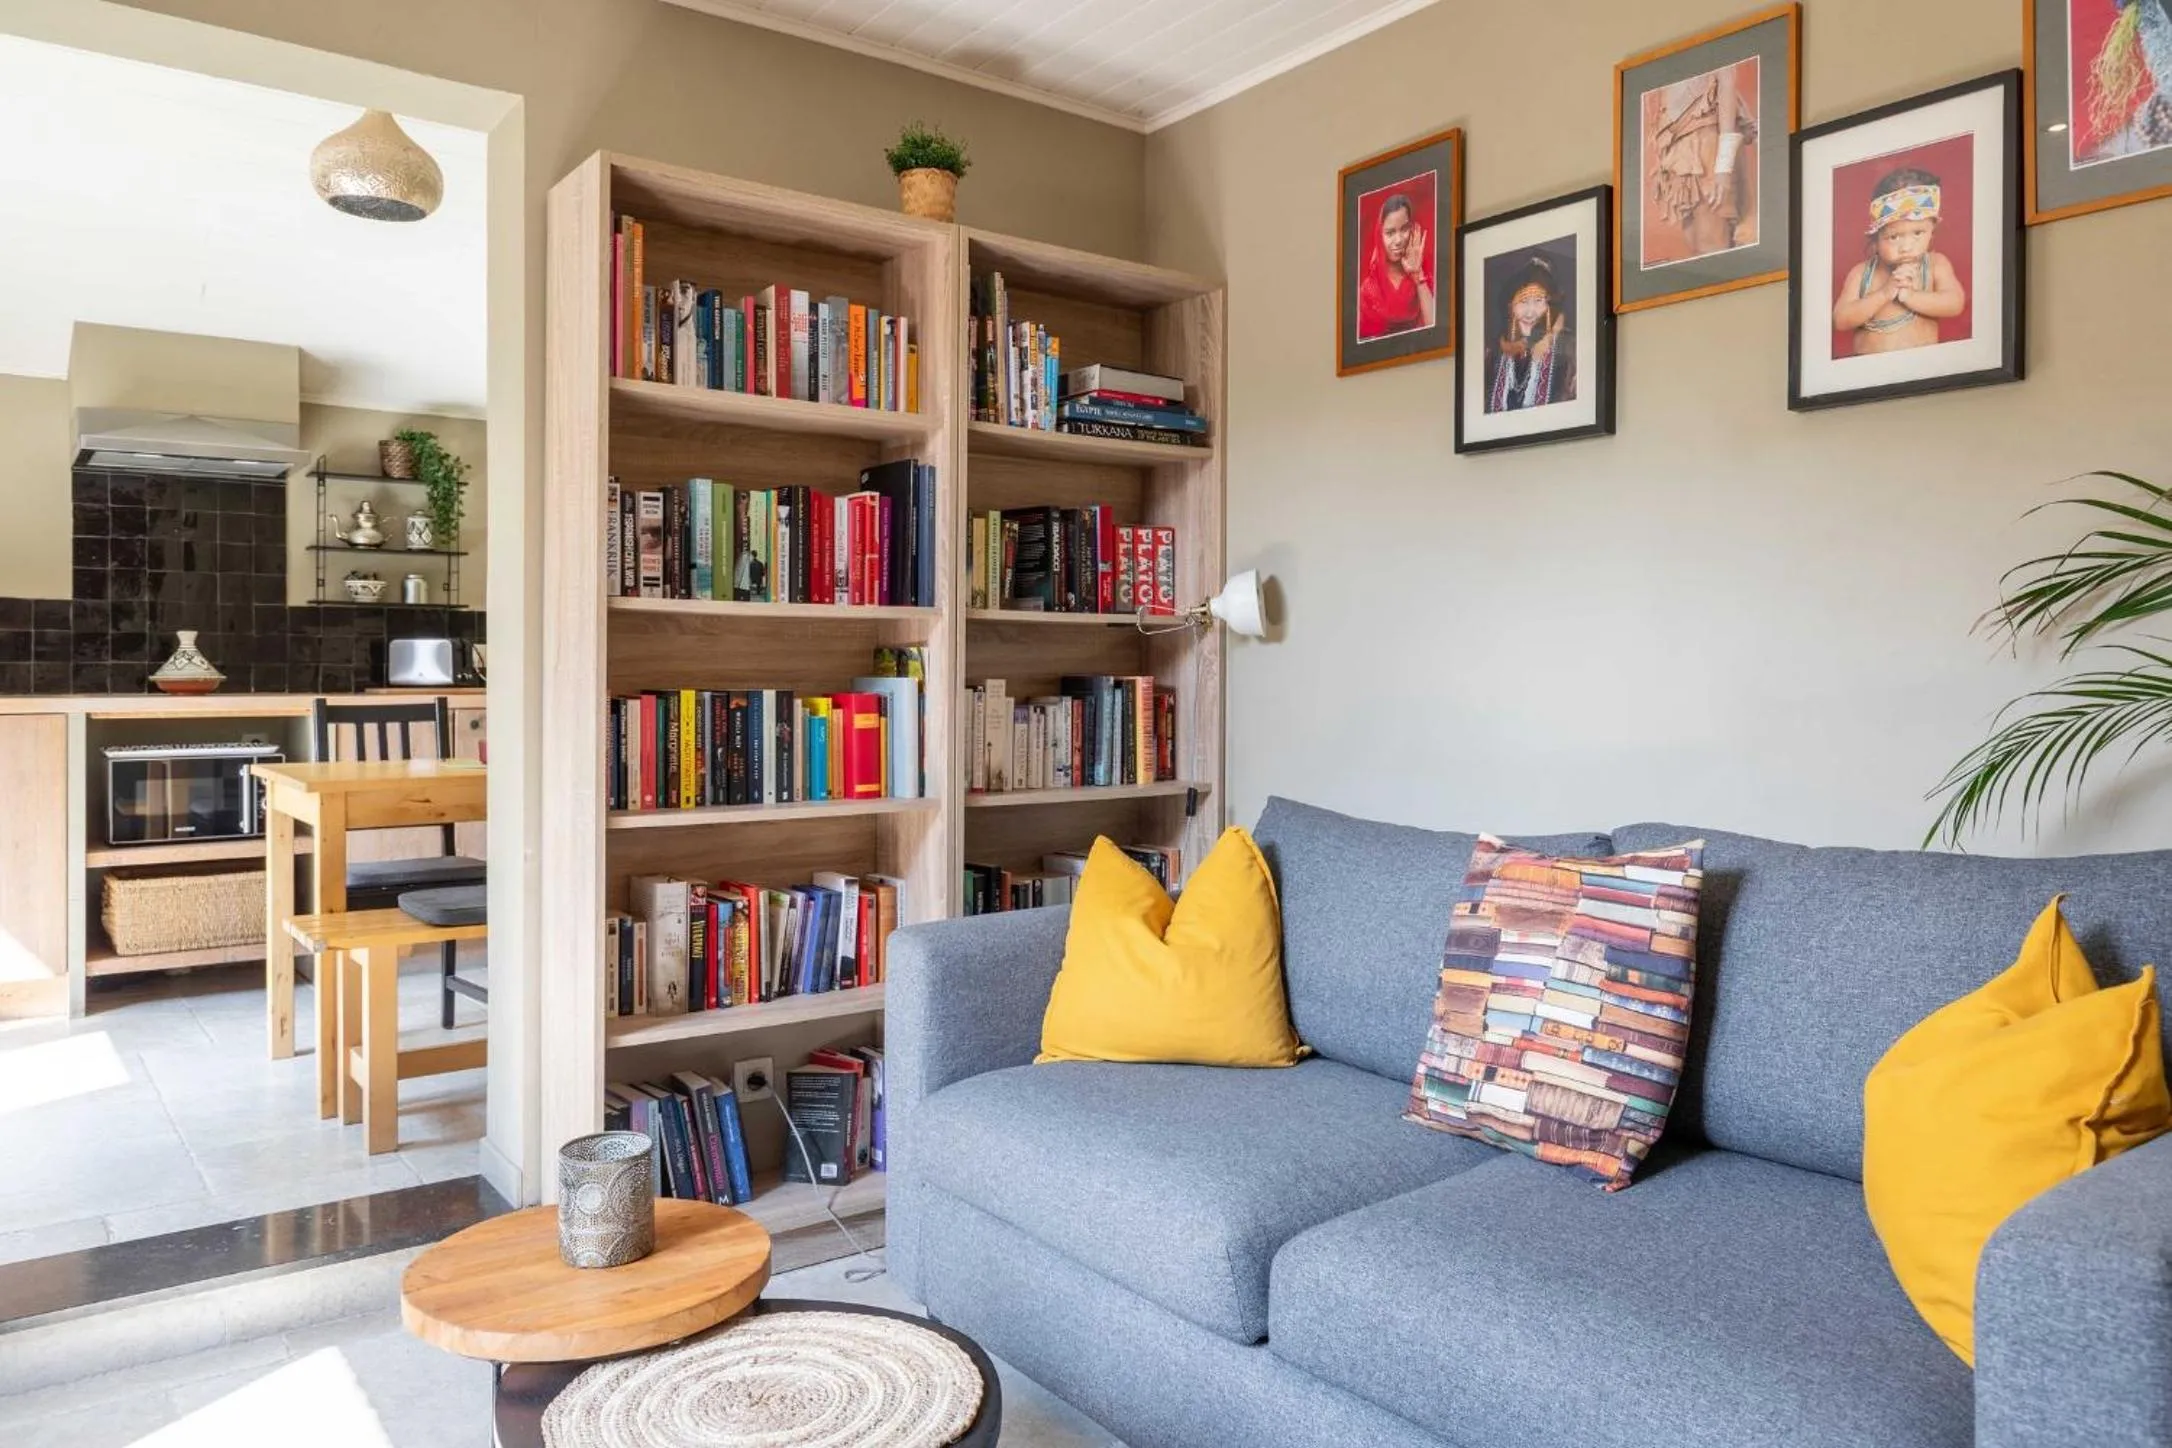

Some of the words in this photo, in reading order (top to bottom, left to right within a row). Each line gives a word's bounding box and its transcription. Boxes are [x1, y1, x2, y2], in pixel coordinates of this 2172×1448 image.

[606, 510, 618, 578] FRANKRIJK
[1118, 527, 1135, 605] PLATO
[1137, 529, 1154, 604] PLATO
[1158, 531, 1174, 604] PLATO
